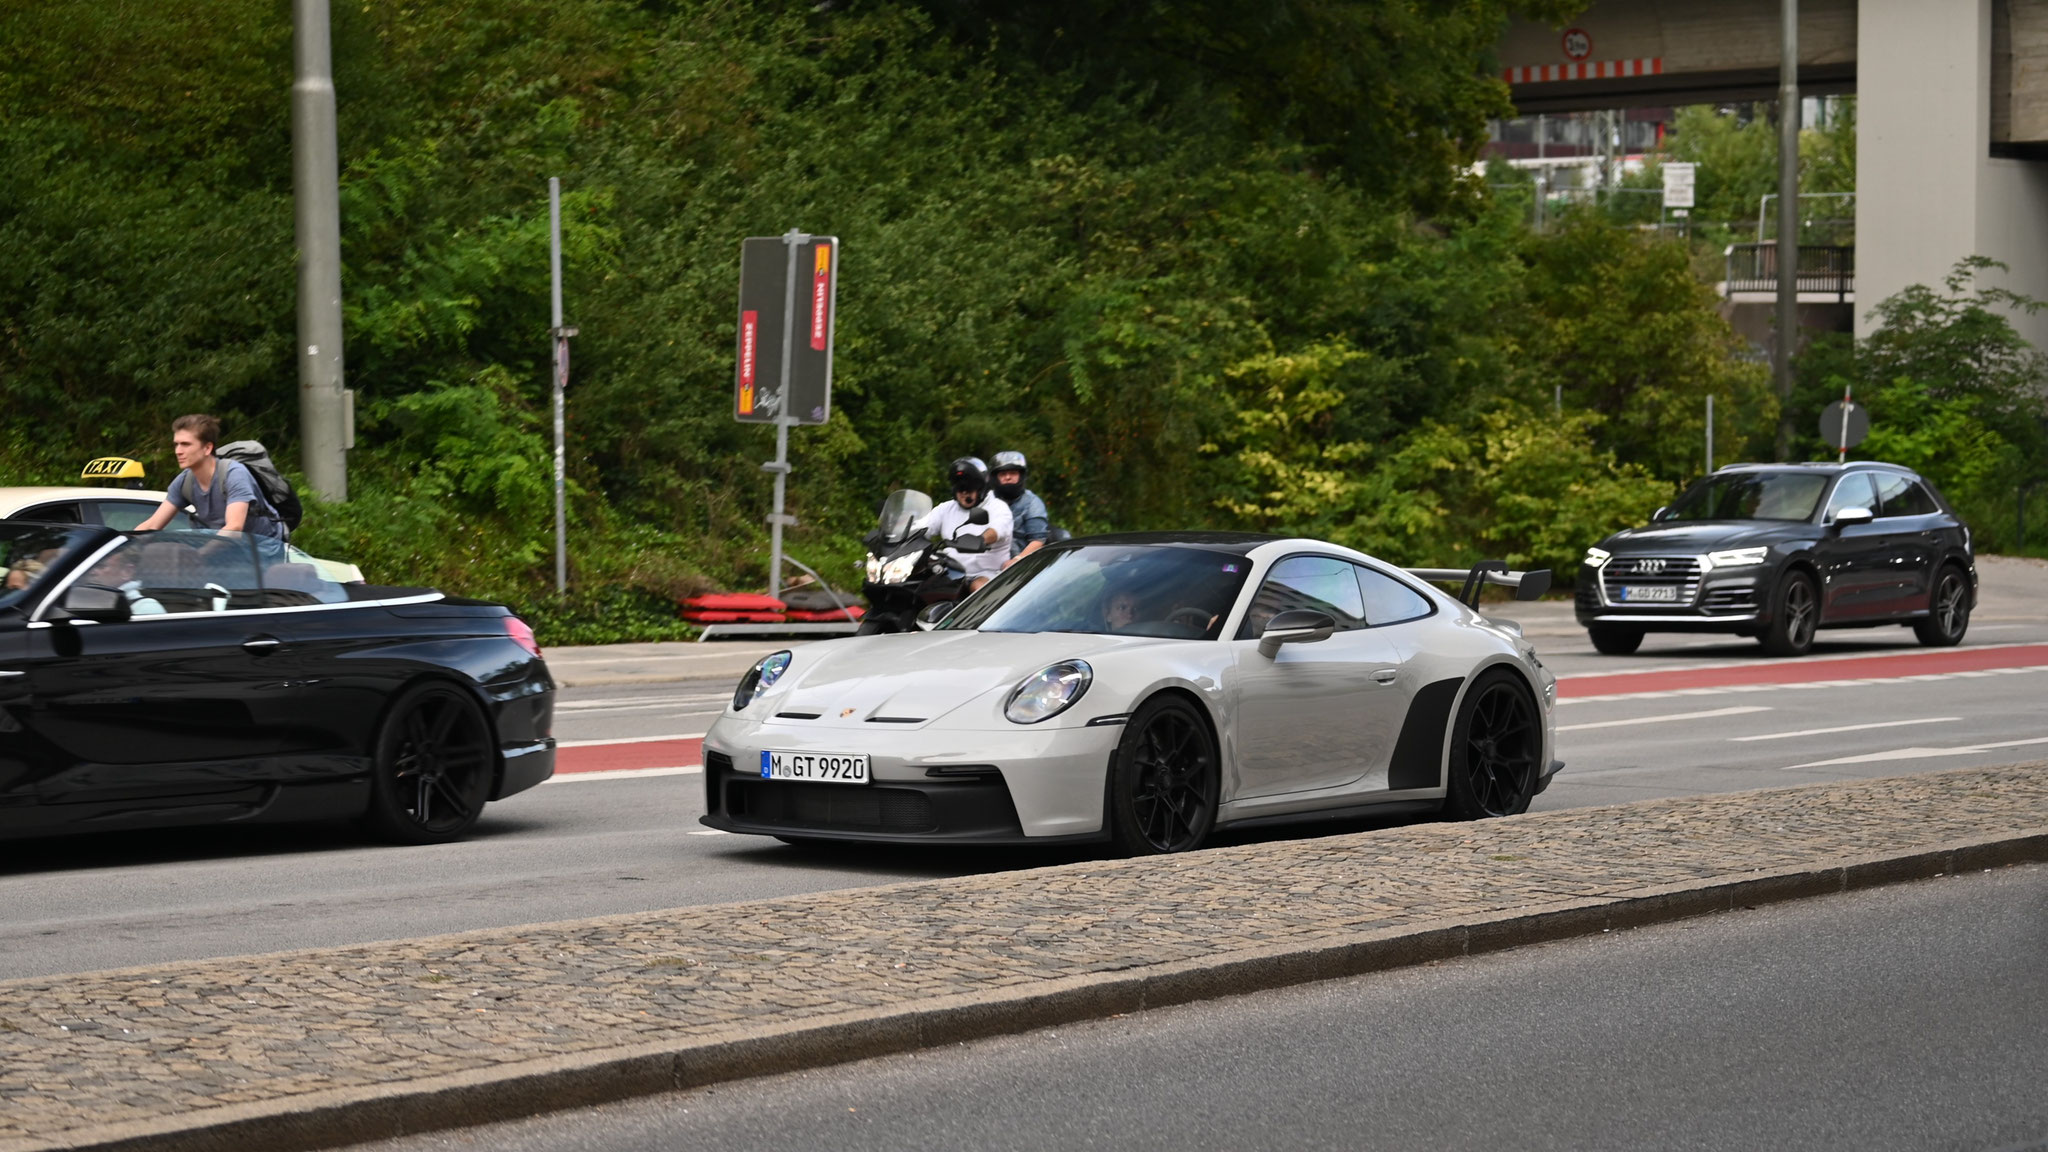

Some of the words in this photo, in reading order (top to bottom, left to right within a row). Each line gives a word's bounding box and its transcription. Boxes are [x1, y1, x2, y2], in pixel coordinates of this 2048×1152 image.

[814, 282, 825, 338] ZEPPELIN
[743, 323, 753, 377] ZEPPELIN
[88, 461, 122, 474] TAXI
[771, 755, 781, 776] M
[793, 756, 815, 778] GT
[819, 758, 864, 779] 9920
